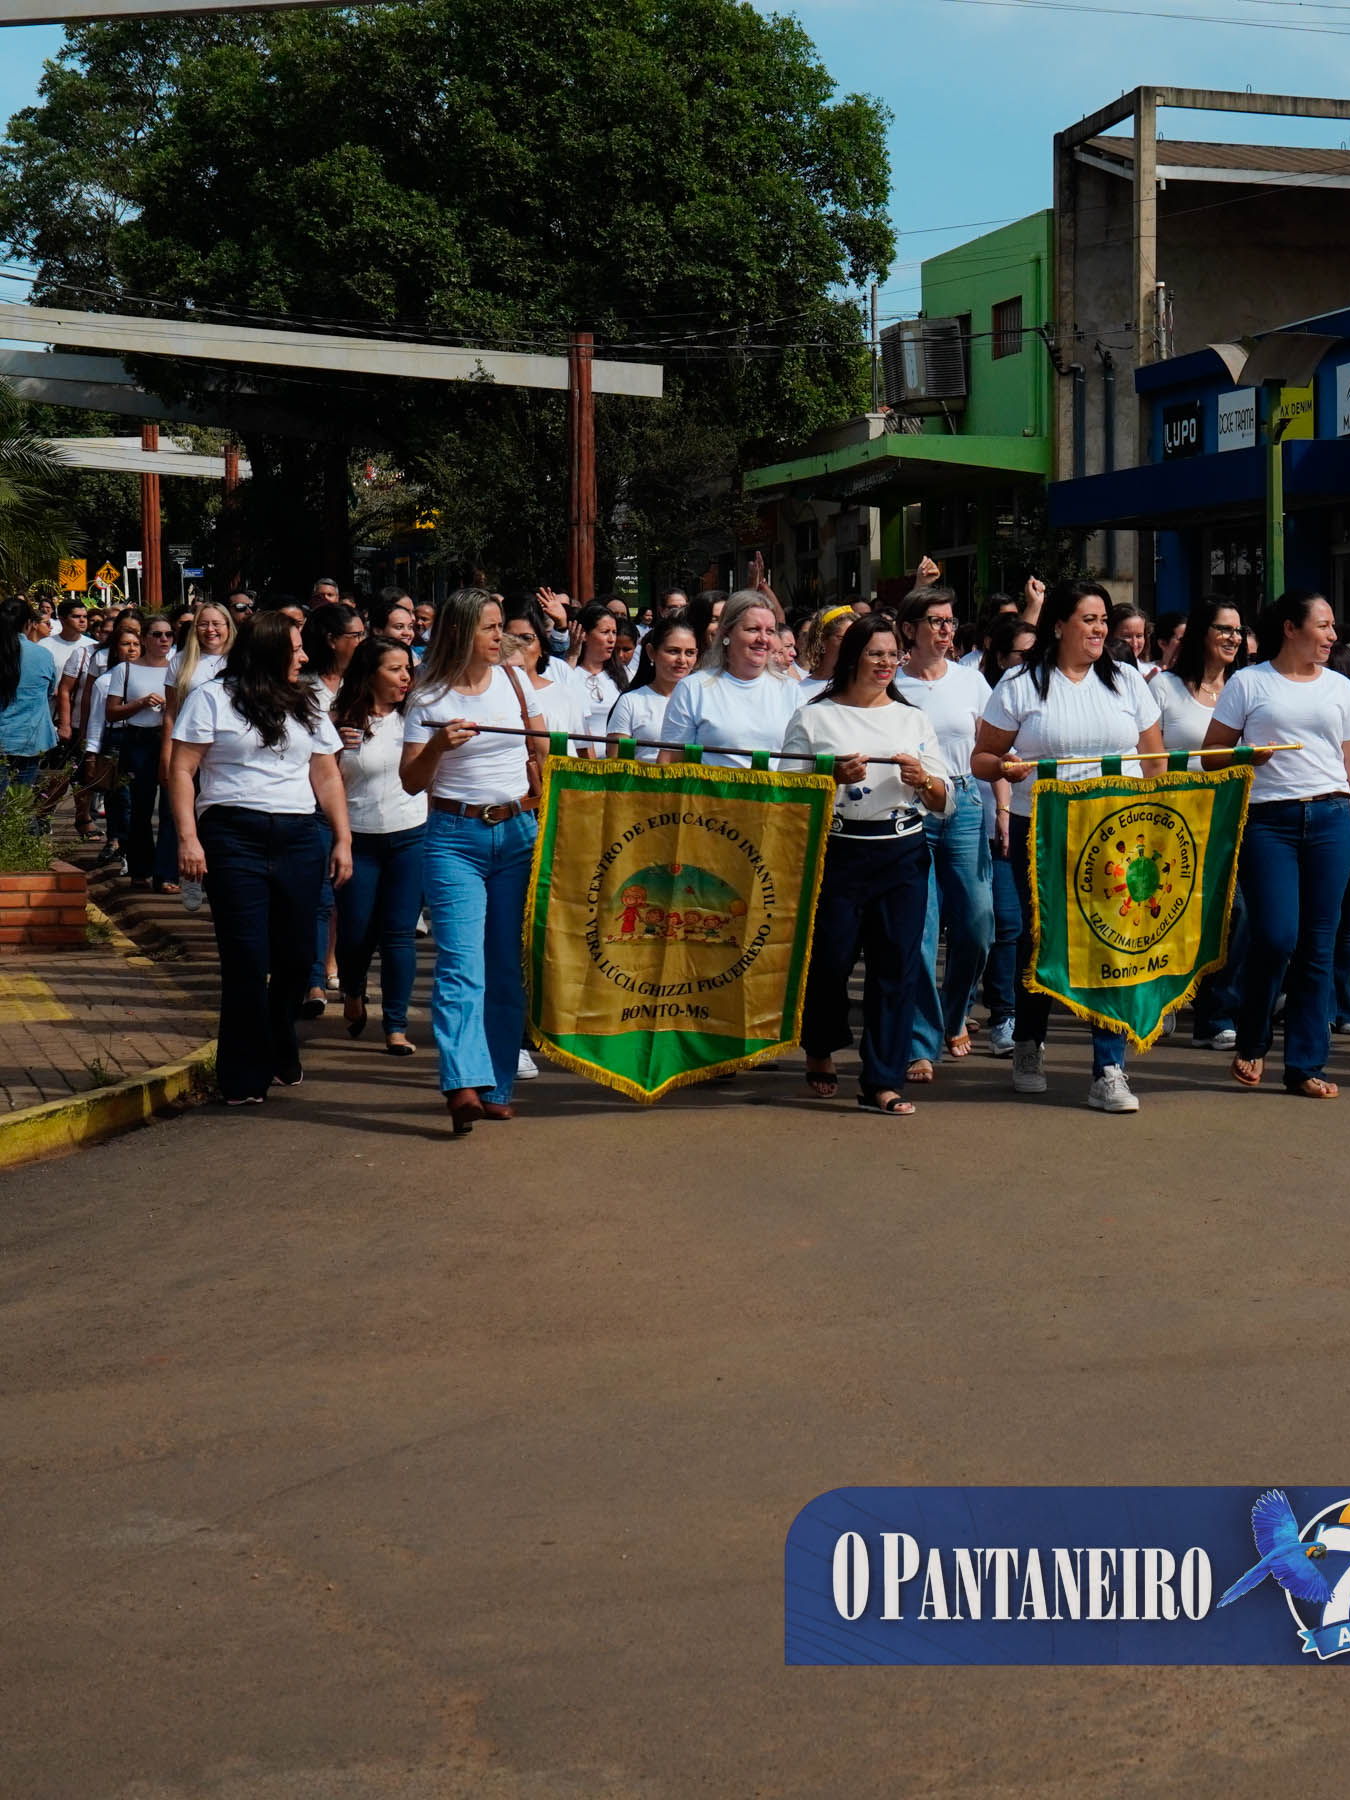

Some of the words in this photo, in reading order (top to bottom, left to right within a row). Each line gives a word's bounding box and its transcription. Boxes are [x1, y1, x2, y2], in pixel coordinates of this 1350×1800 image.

[1291, 399, 1313, 415] DENIM
[1164, 417, 1197, 454] LUPO
[586, 841, 623, 905] CENTRO
[622, 822, 646, 843] DE
[647, 812, 740, 842] EDUCAÇÃO
[738, 839, 776, 910] INFANTIL
[1080, 845, 1100, 893] Centro
[1100, 826, 1116, 842] de
[1118, 810, 1176, 830] Educação
[1175, 826, 1192, 879] Infantil
[1090, 912, 1131, 948] IZALTINA
[1156, 897, 1184, 937] COELHO
[585, 918, 601, 963] VERA
[598, 959, 635, 993] LÚCIA
[637, 982, 694, 998] GHIZZI
[697, 924, 772, 993] FIGUEIREDO
[620, 1002, 710, 1023] BONITO-MS
